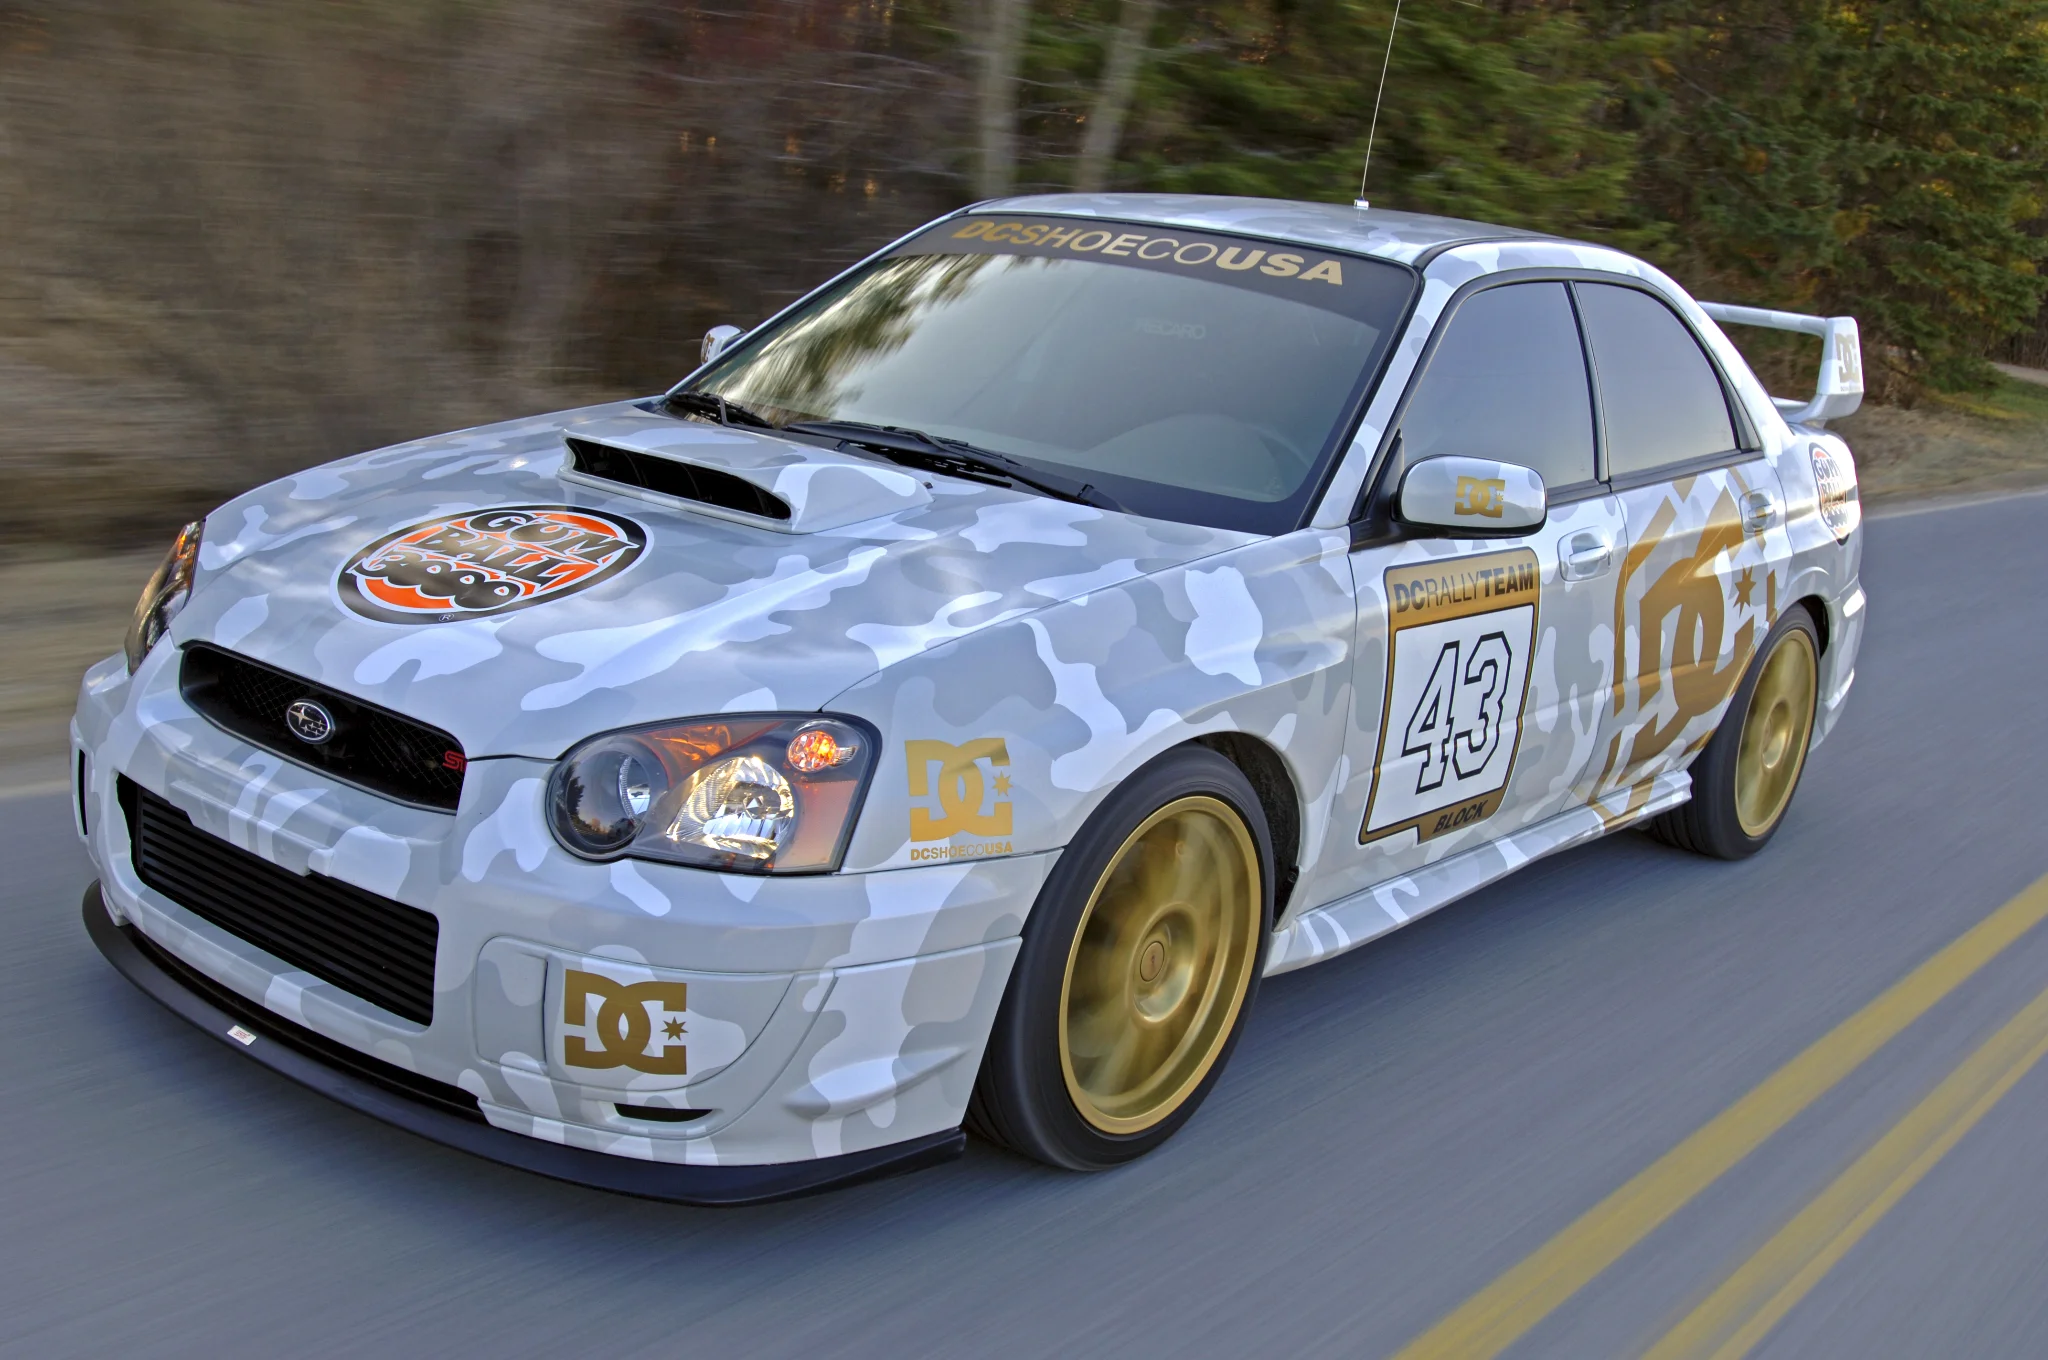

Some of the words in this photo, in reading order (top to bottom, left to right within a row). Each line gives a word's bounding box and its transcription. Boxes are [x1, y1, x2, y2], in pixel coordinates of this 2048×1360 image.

[1454, 476, 1505, 518] DC
[399, 525, 601, 592] BALL
[469, 511, 639, 564] GUM
[346, 550, 526, 611] 3000
[1400, 630, 1512, 795] 43
[904, 737, 1013, 842] DC
[1432, 800, 1488, 834] BLOCK
[910, 841, 1013, 861] DCSHOECOUSA
[564, 968, 688, 1075] DC
